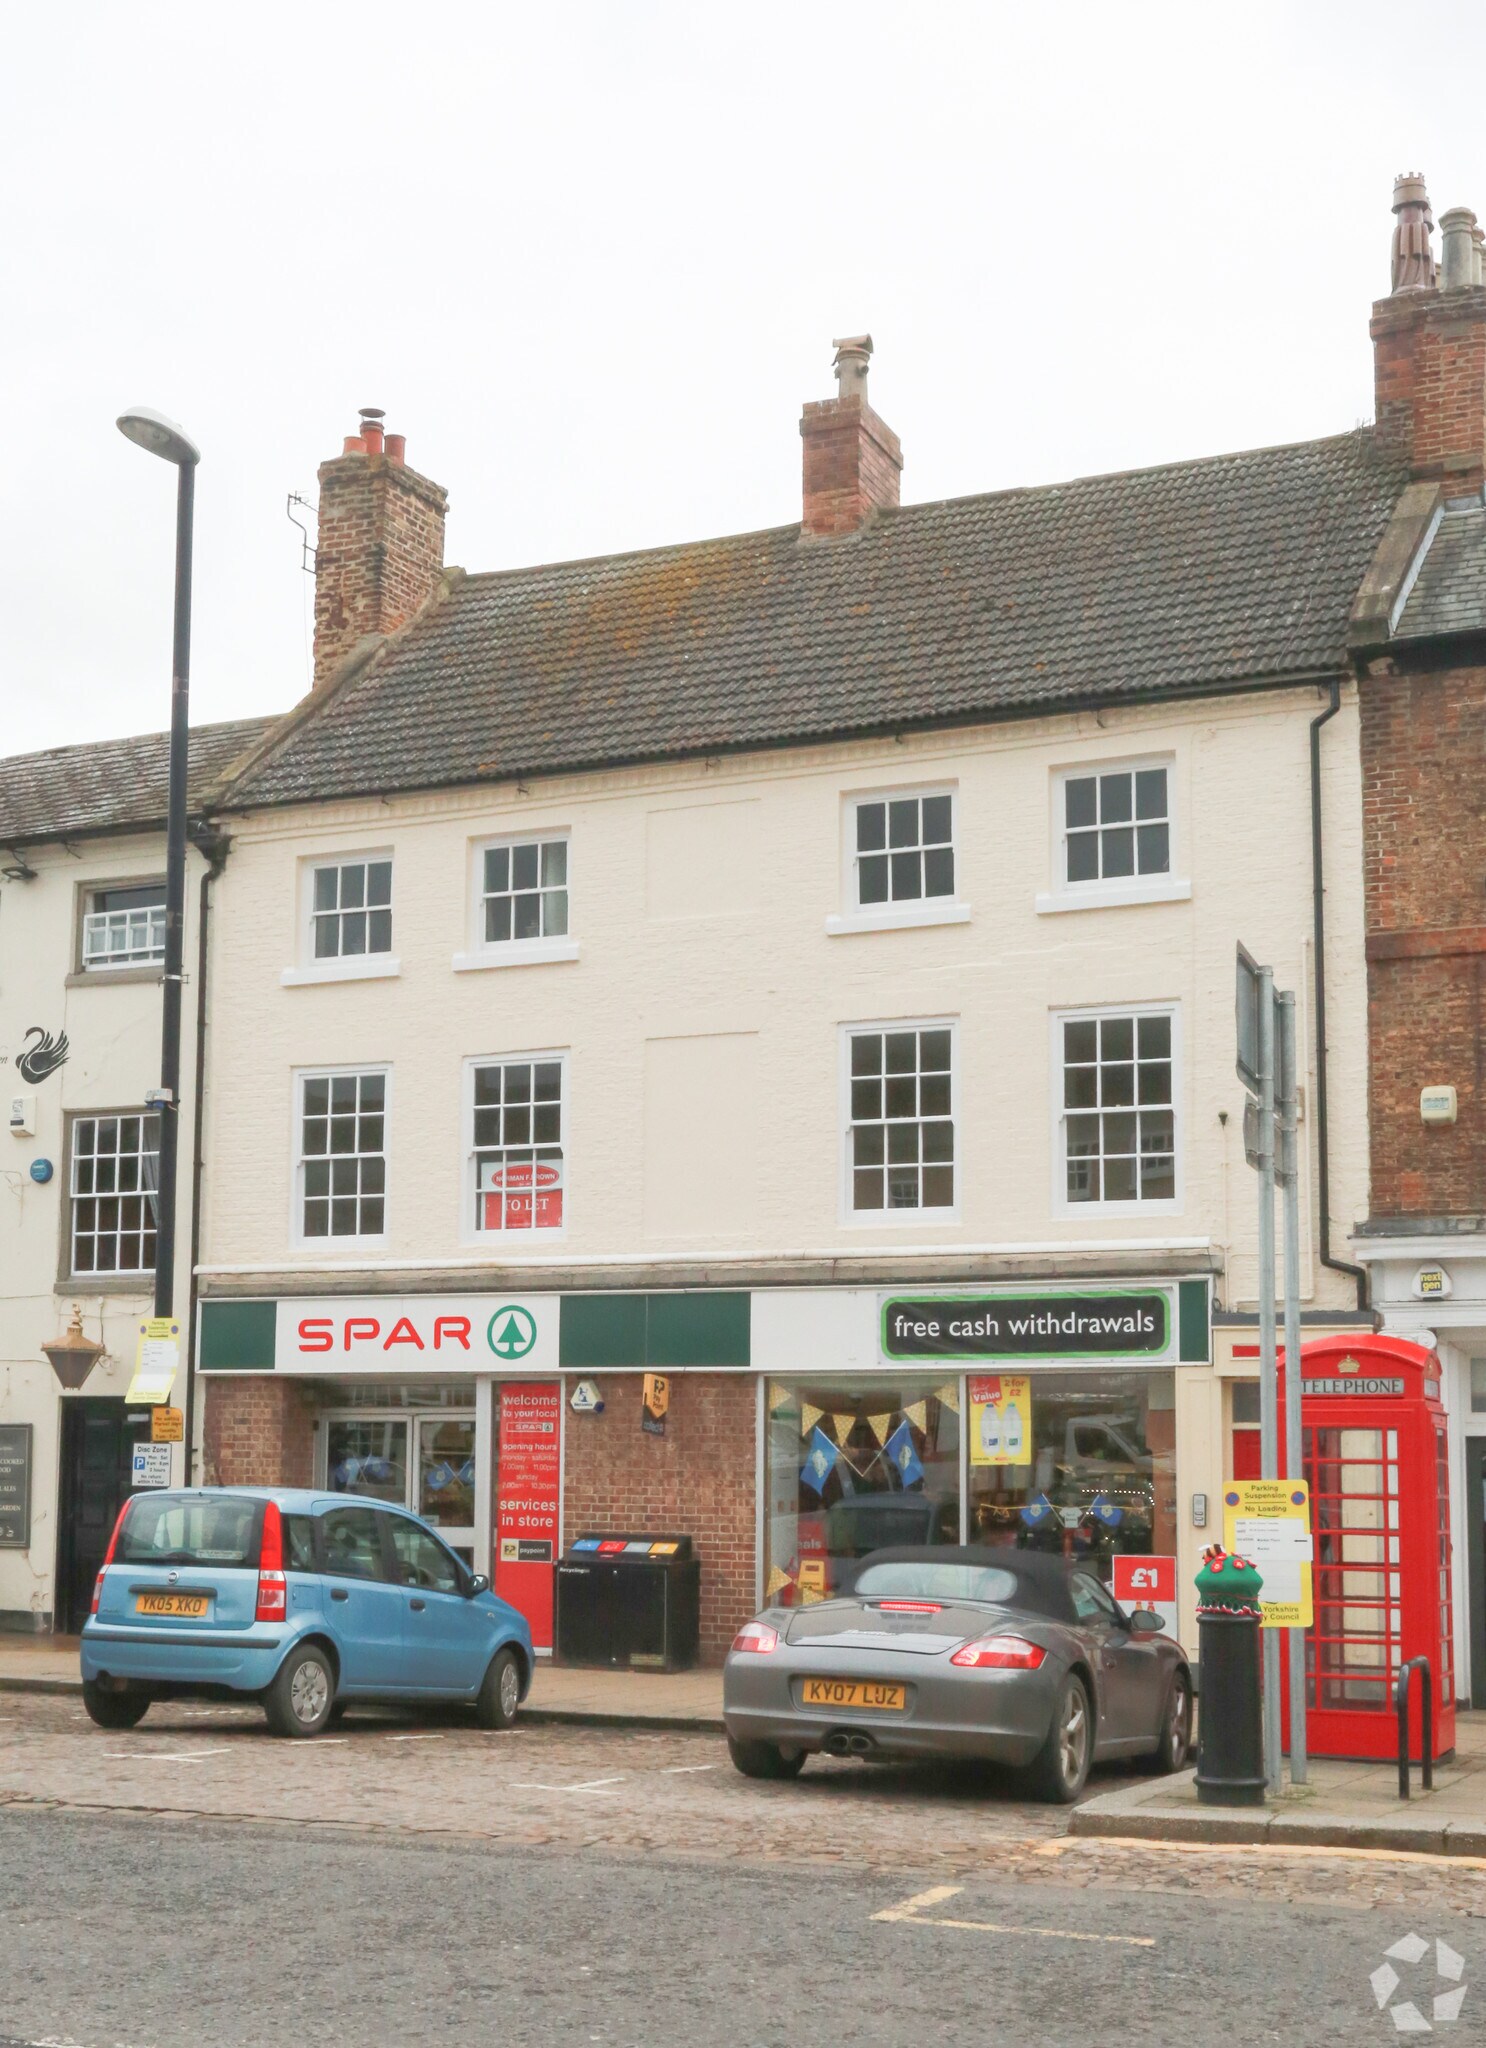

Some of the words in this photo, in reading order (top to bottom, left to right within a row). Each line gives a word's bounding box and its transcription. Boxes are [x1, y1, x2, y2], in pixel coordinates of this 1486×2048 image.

[1421, 1273, 1441, 1282] next
[1423, 1281, 1441, 1291] gen
[895, 1316, 940, 1337] free
[949, 1314, 999, 1336] cash
[1008, 1310, 1155, 1335] withdrawals
[298, 1316, 471, 1352] SPAR
[1011, 1378, 1026, 1387] for
[1301, 1379, 1400, 1394] TELEPHONE
[503, 1395, 558, 1406] welcome
[503, 1409, 512, 1417] to
[514, 1410, 534, 1419] your
[536, 1409, 558, 1418] local
[502, 1443, 533, 1452] opening
[535, 1442, 557, 1451] hours
[1251, 1485, 1279, 1493] Parking
[1244, 1492, 1287, 1500] Suspension
[500, 1499, 556, 1511] services
[502, 1514, 514, 1526] in
[518, 1515, 553, 1527] store
[1131, 1567, 1158, 1588] £1
[142, 1595, 173, 1610] YK05
[810, 1682, 857, 1704] KY07
